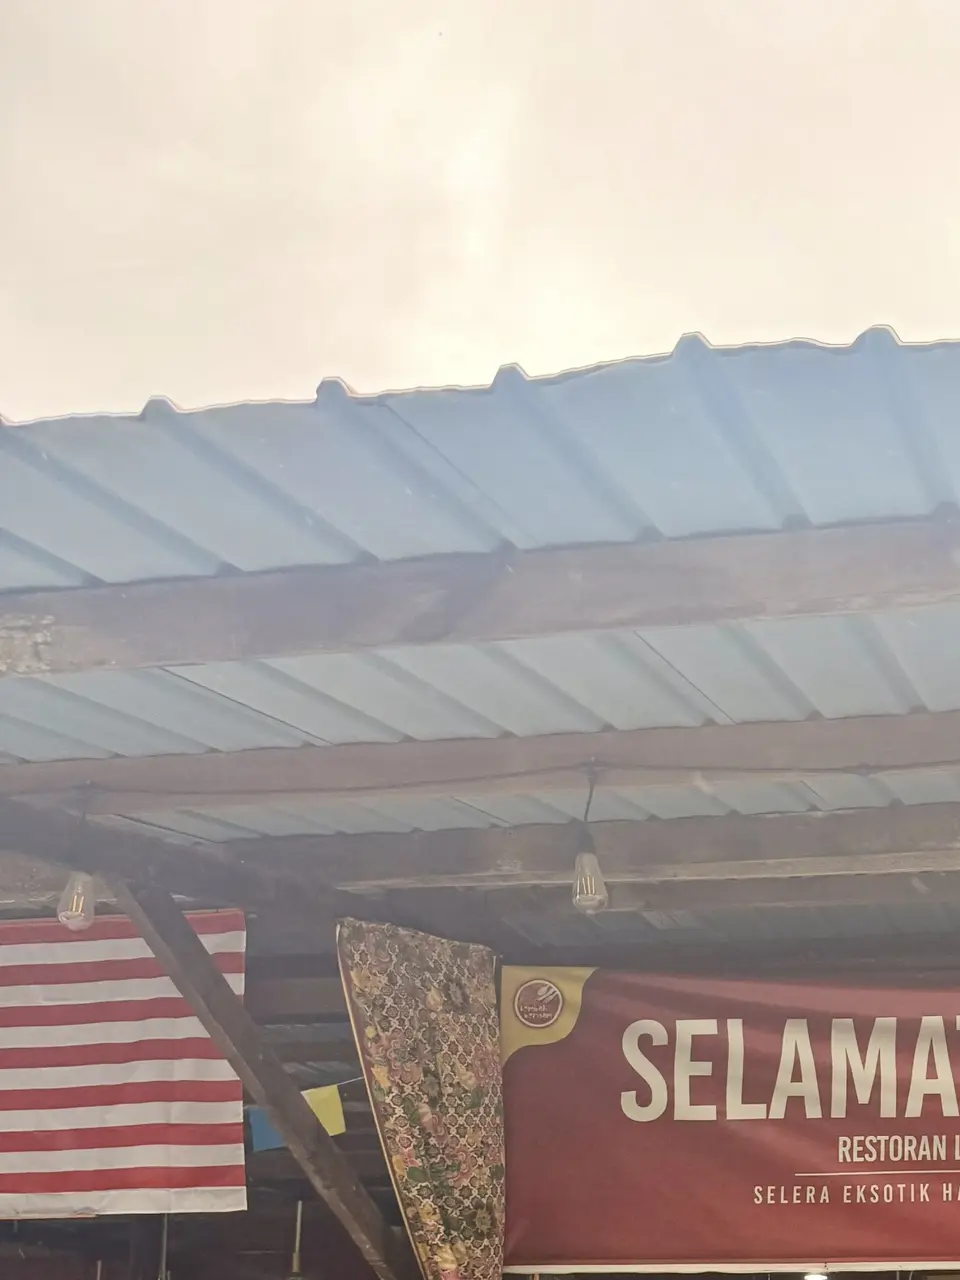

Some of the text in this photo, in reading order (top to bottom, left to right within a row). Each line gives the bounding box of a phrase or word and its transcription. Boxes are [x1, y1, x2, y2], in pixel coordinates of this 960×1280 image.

[838, 1135, 947, 1163] RESTORAN
[753, 1185, 830, 1204] SELERA
[843, 1183, 930, 1203] EKSOTIK
